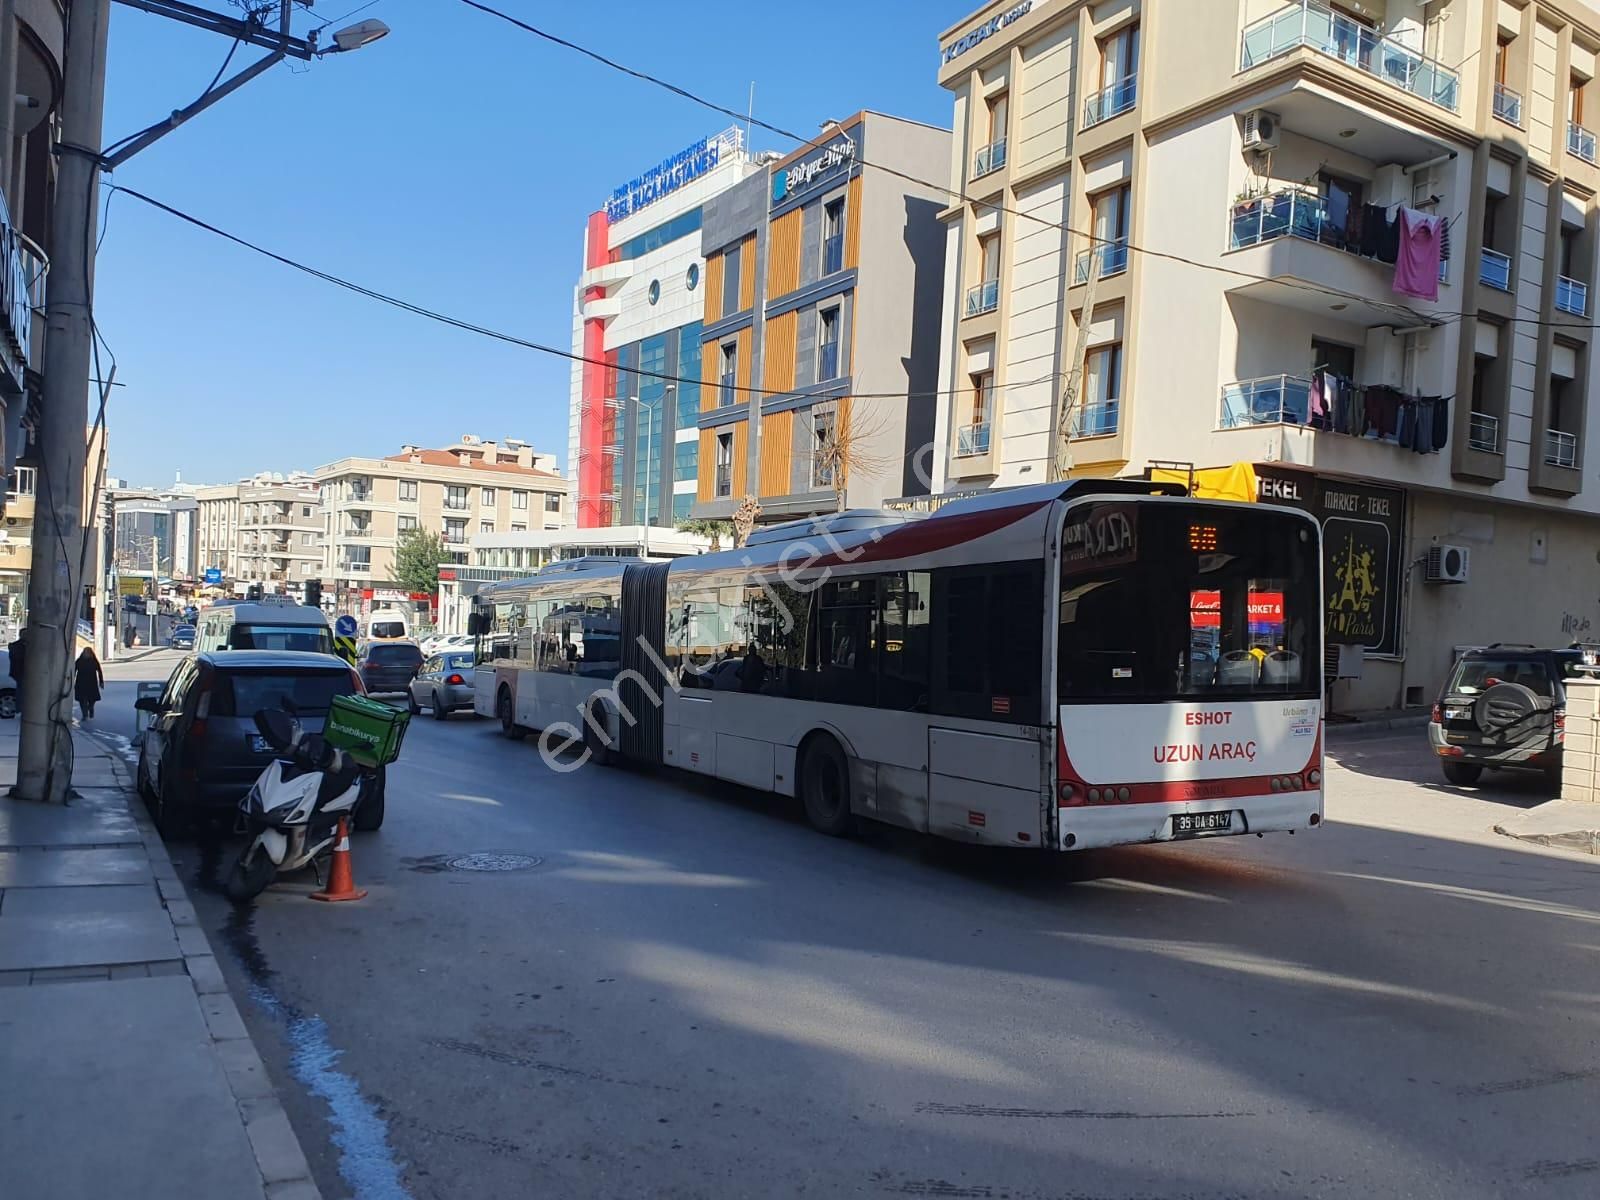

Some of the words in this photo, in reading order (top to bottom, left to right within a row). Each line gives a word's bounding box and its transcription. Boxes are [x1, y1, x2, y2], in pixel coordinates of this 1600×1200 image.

[1256, 475, 1302, 500] TEKEL
[1325, 491, 1359, 511] MARKET
[1368, 497, 1390, 516] TEKEL
[1345, 612, 1374, 636] Paris
[1185, 712, 1232, 725] ESHOT
[1154, 744, 1203, 763] UZUN
[1209, 741, 1257, 762] ARAÇ
[1180, 816, 1191, 829] 35
[1195, 815, 1205, 828] DA
[1209, 813, 1229, 827] 6147
